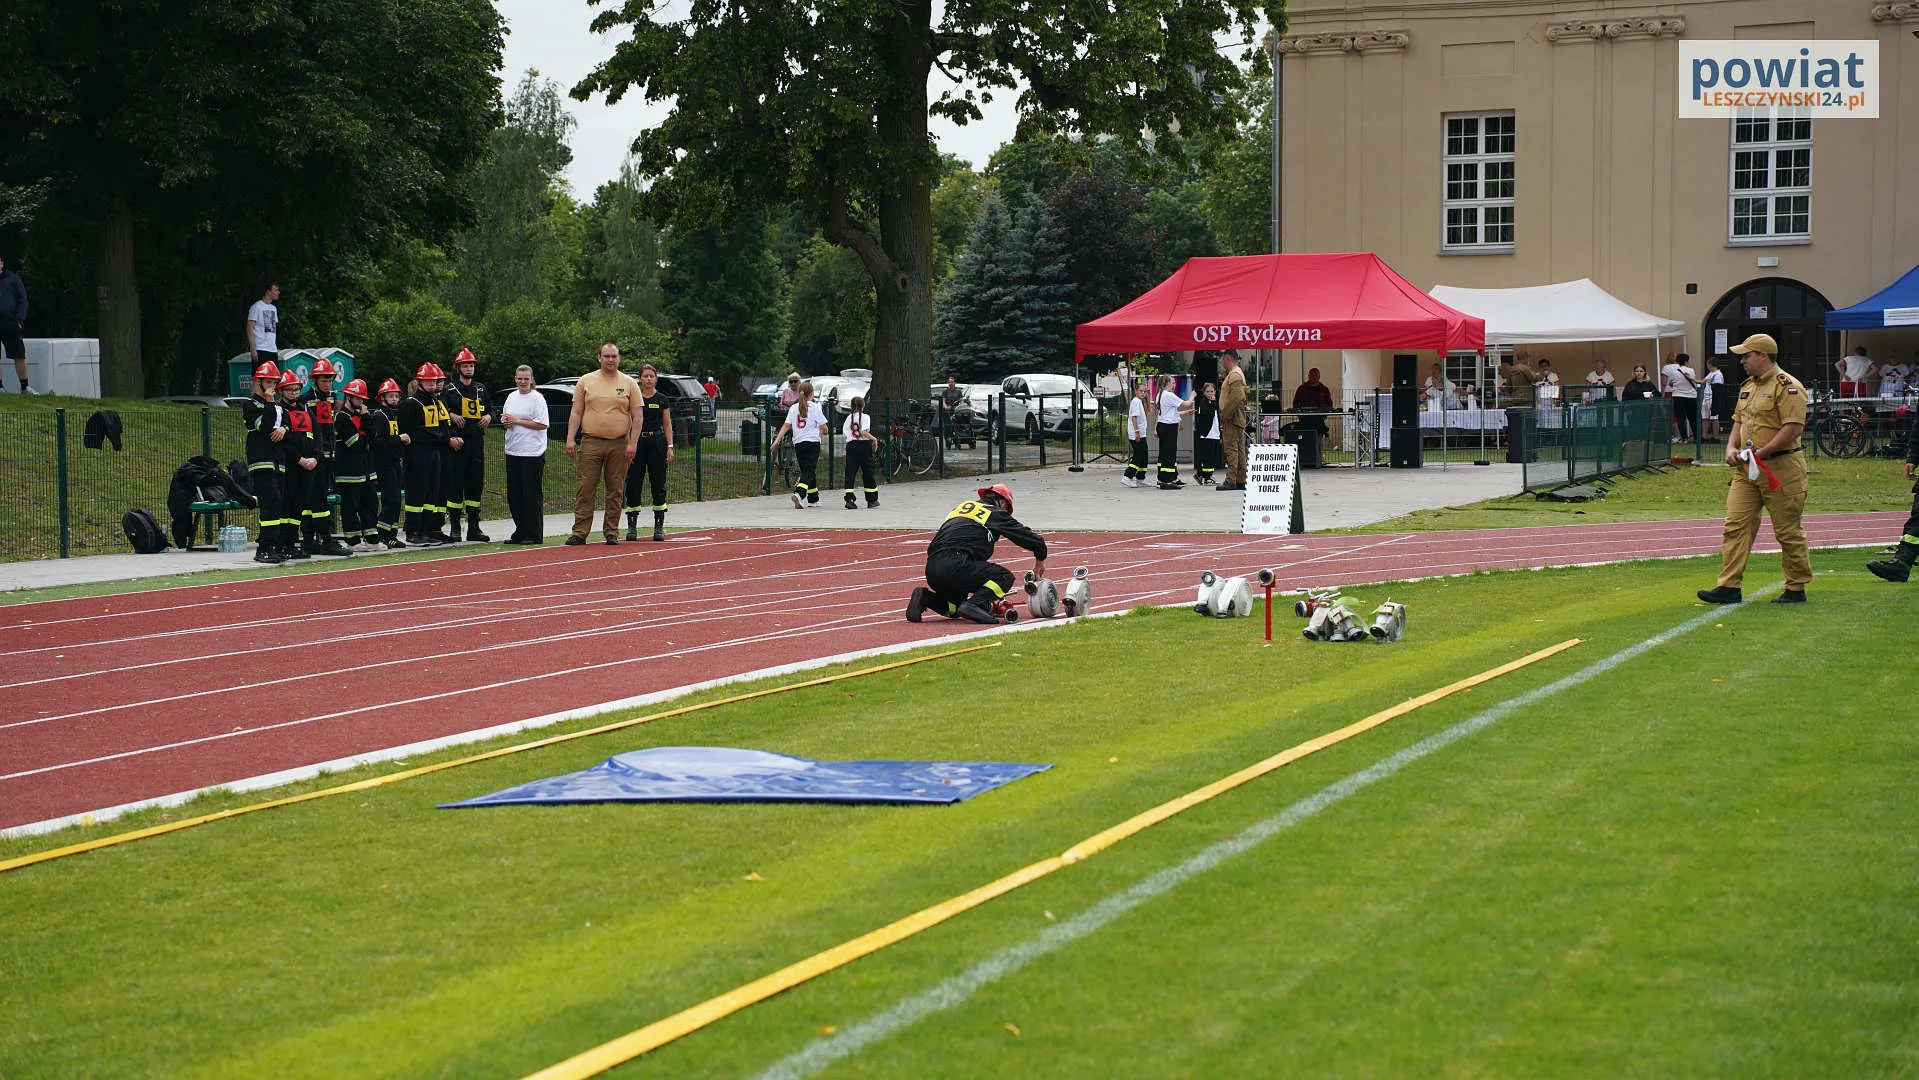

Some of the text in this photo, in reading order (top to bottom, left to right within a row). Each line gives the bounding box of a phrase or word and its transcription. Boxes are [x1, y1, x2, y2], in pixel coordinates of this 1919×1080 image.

[1193, 324, 1322, 346] OSP Rydzyna
[321, 402, 330, 419] 3
[467, 400, 477, 415] 9
[294, 412, 308, 428] 2
[428, 408, 435, 424] 7
[1255, 453, 1288, 461] PROSIMY
[1251, 474, 1261, 482] PO
[1258, 484, 1280, 493] TORZE
